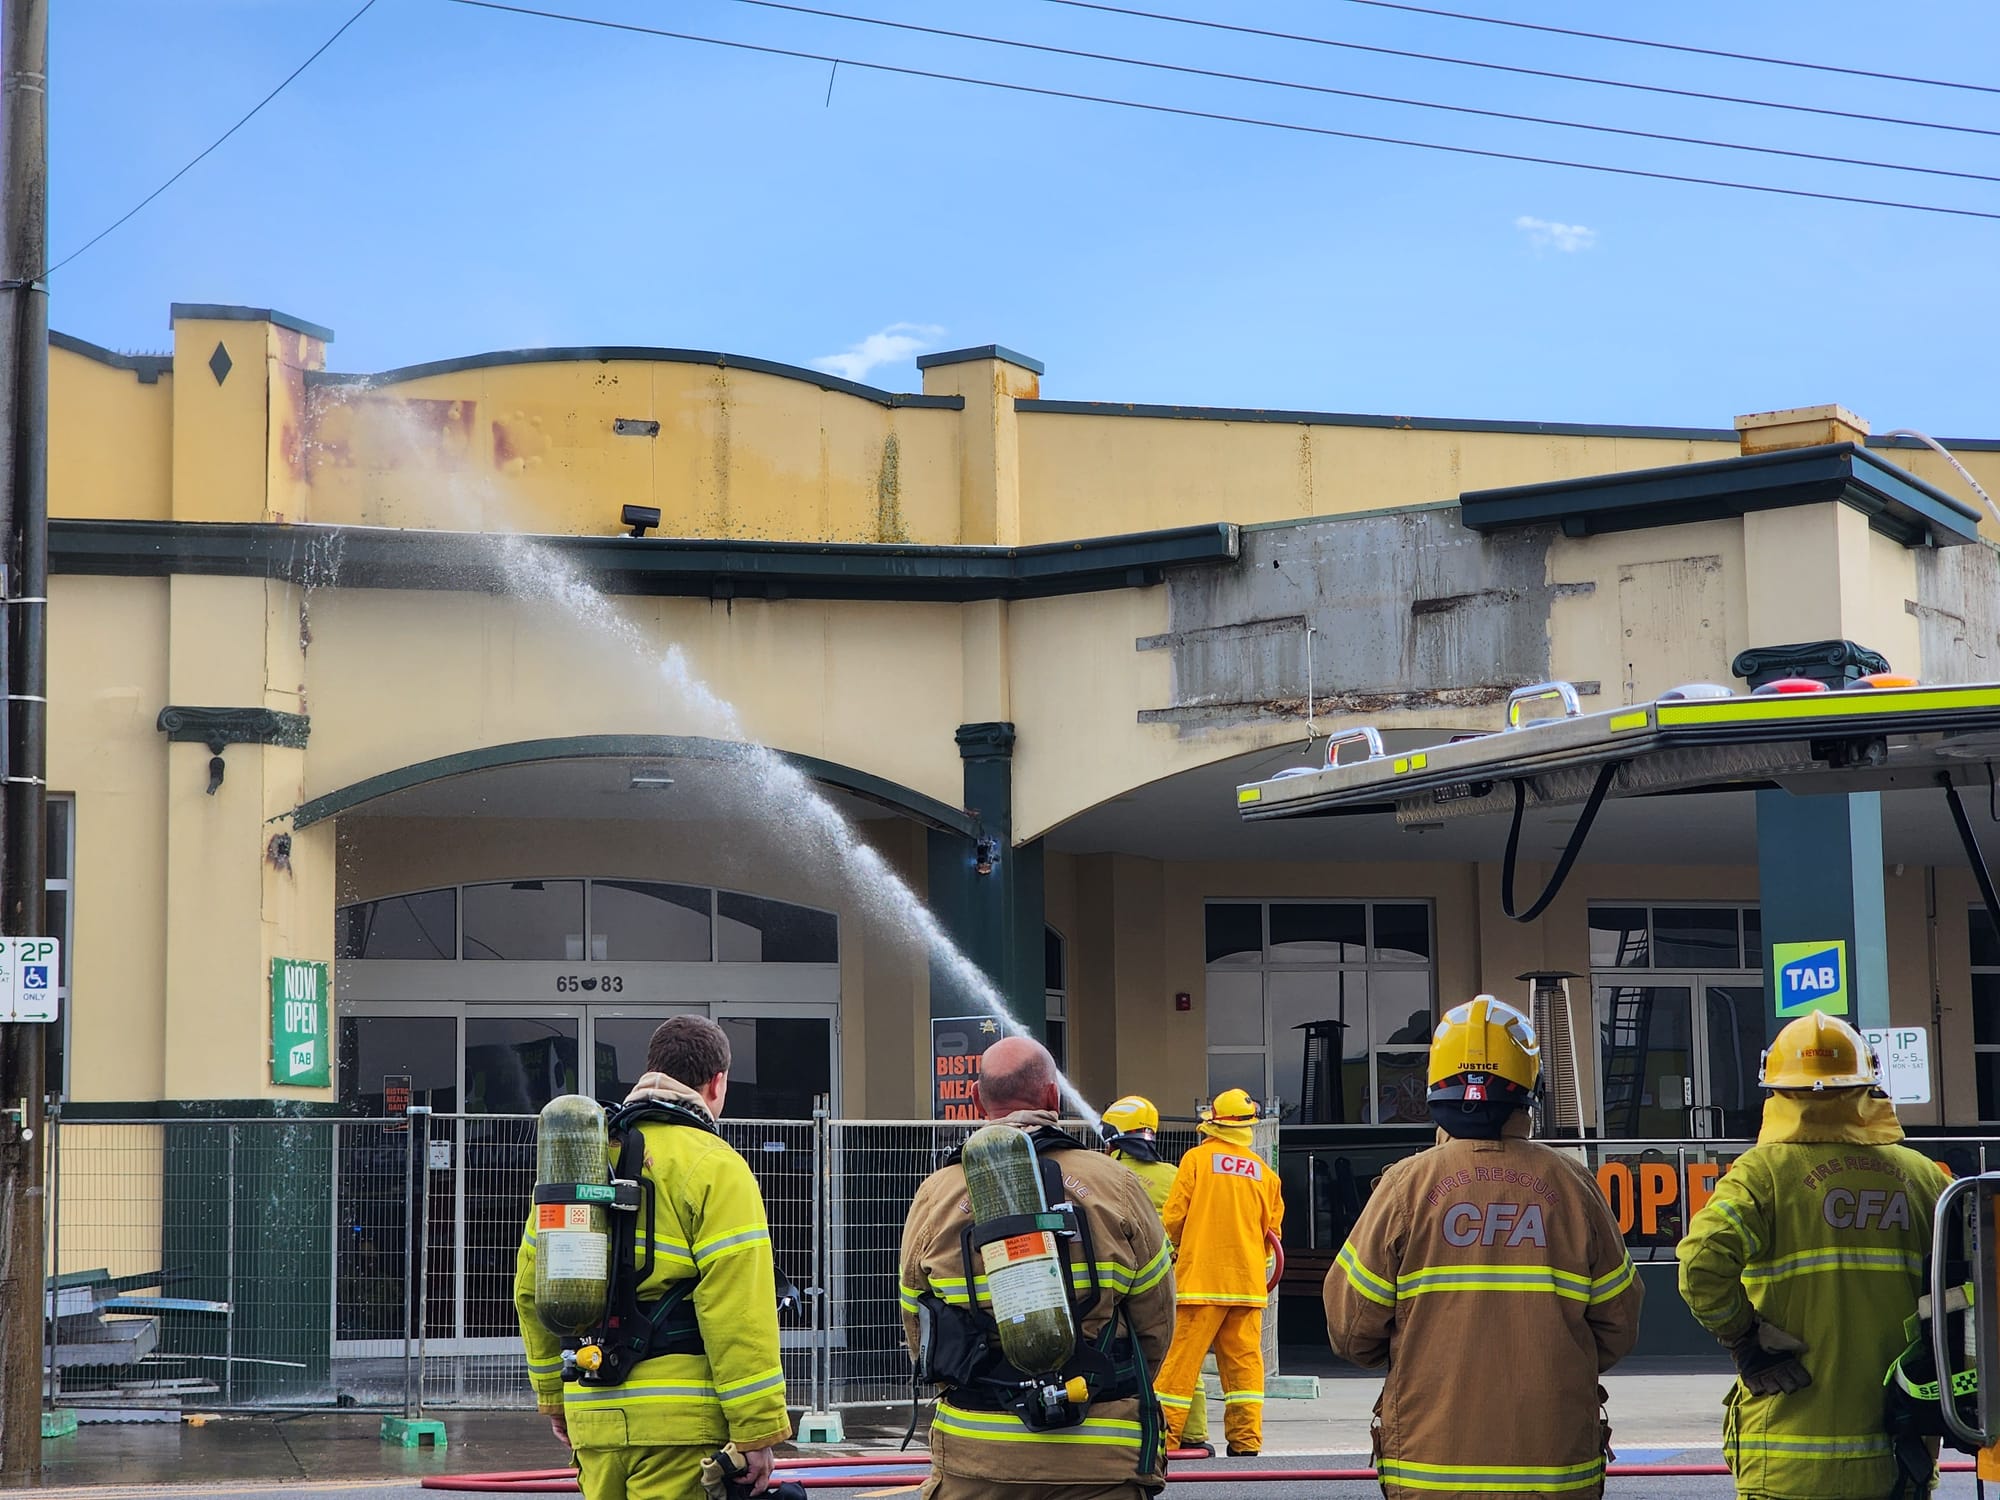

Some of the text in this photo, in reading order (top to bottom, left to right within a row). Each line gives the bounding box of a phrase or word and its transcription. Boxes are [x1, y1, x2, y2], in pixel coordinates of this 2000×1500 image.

[20, 943, 53, 961] 2P
[285, 965, 317, 1001] NOW
[556, 976, 623, 992] 65 83
[1786, 967, 1835, 991] TAB
[23, 993, 46, 1001] ONLY
[285, 1001, 317, 1034] OPEN
[1896, 1032, 1918, 1050] 1P
[293, 1052, 312, 1065] TAB
[936, 1054, 983, 1076] BIST
[940, 1079, 978, 1100] MEA
[1221, 1156, 1256, 1177] CFA
[1803, 1158, 1844, 1190] FIRE
[578, 1186, 614, 1200] MSA
[1426, 1166, 1561, 1207] FIRE RESCUE
[1594, 1161, 1734, 1236] OPE
[1822, 1187, 1911, 1232] CFA
[1441, 1201, 1549, 1248] CFA
